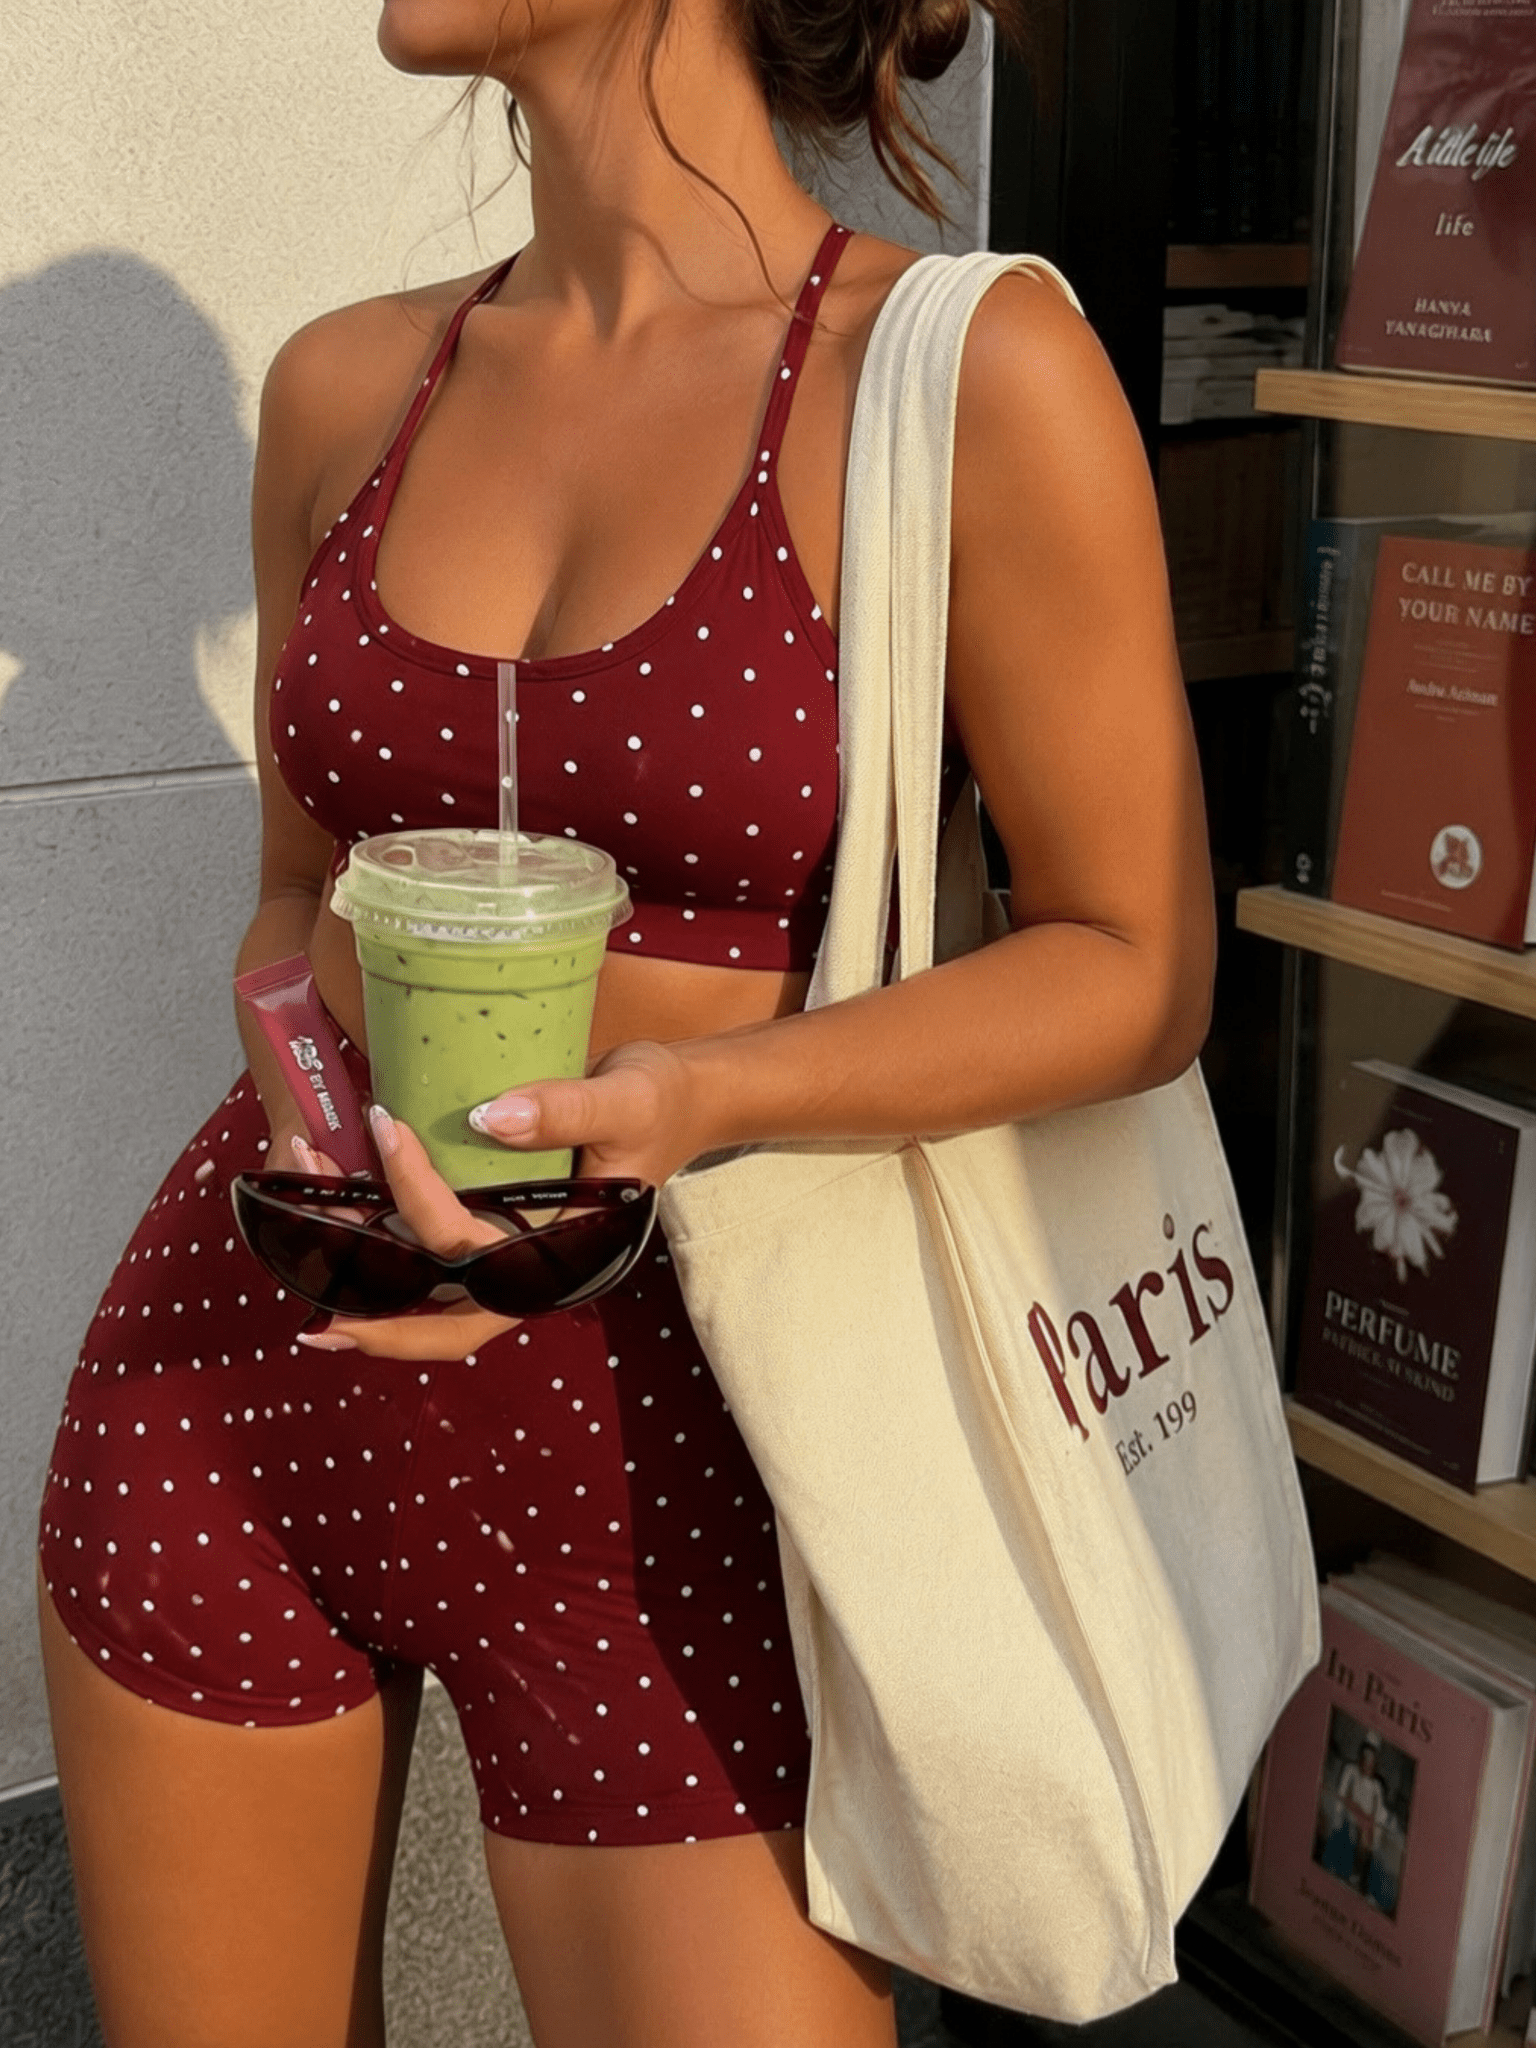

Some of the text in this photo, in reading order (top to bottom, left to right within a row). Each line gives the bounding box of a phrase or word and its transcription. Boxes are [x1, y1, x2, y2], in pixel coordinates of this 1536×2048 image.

[1395, 124, 1433, 167] A
[1434, 212, 1475, 237] life
[1401, 561, 1533, 597] CALL ME BY
[1398, 597, 1536, 636] YOUR NAME
[1027, 1212, 1235, 1443] Paris
[1324, 1288, 1462, 1381] PERFUME
[1114, 1390, 1197, 1476] Est. 199
[1327, 1648, 1434, 1743] In Paris
